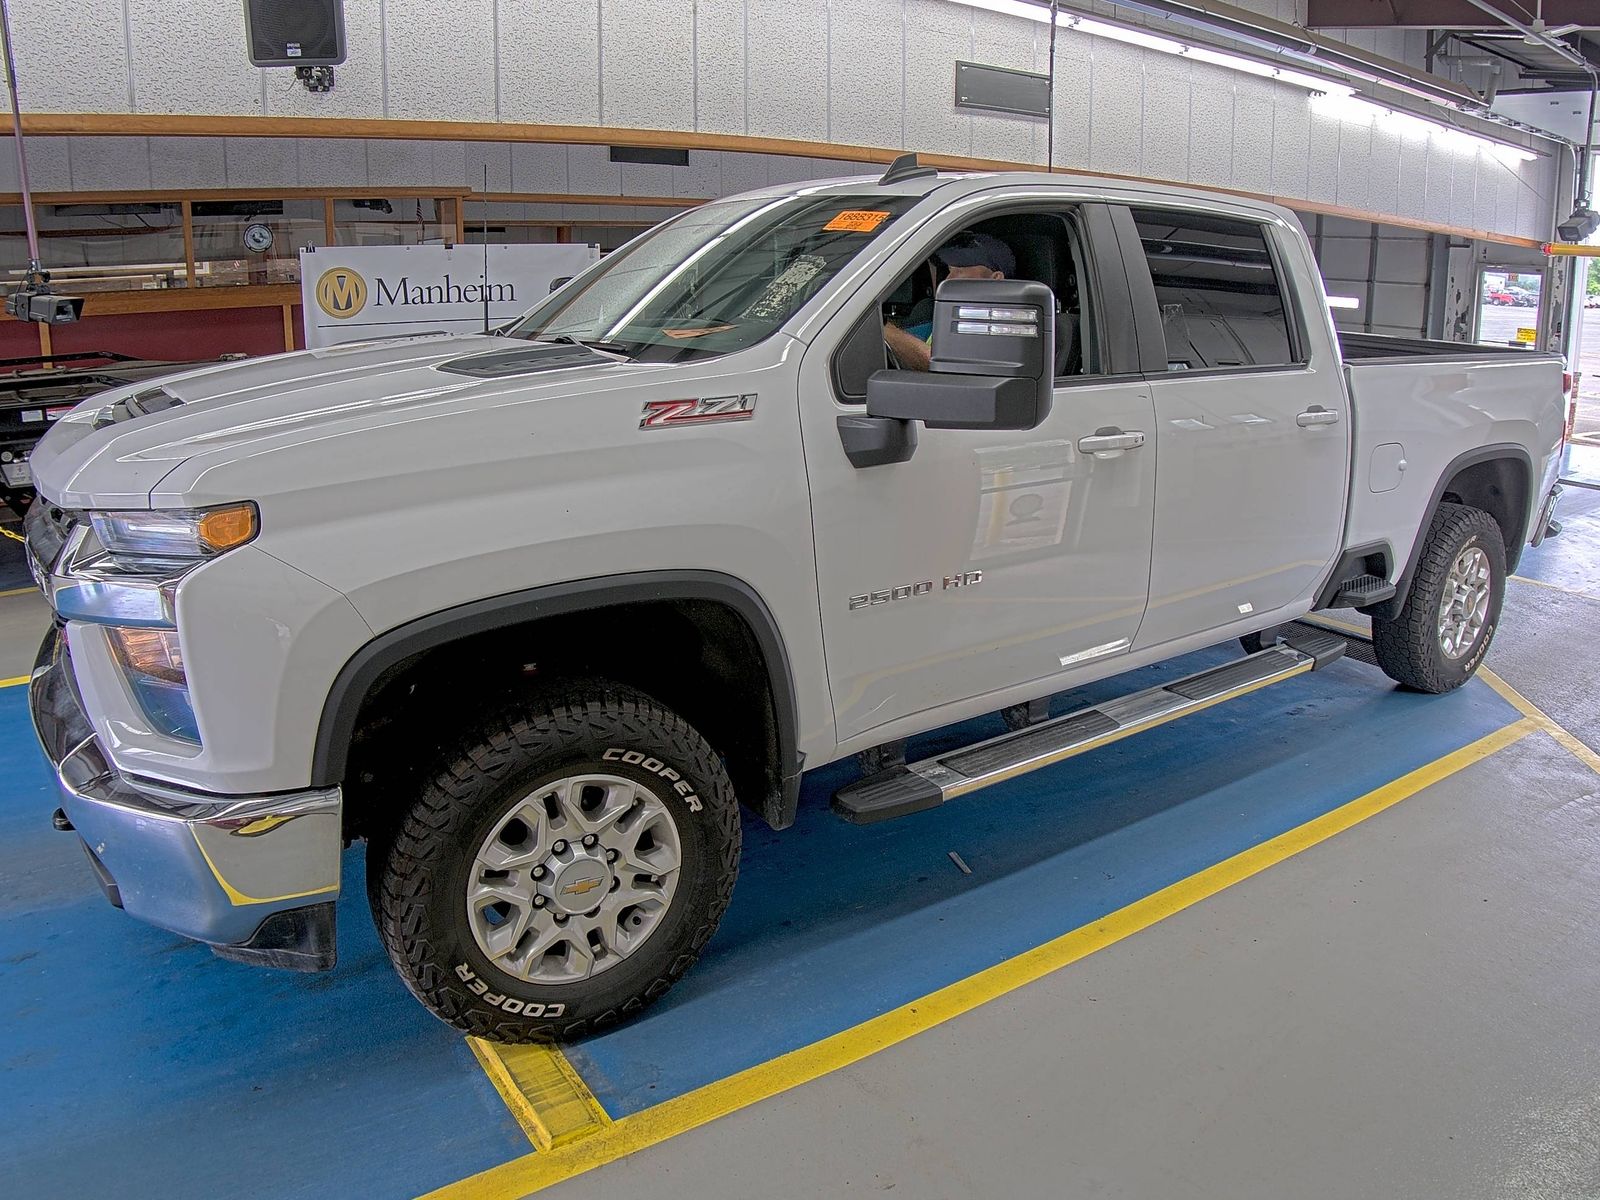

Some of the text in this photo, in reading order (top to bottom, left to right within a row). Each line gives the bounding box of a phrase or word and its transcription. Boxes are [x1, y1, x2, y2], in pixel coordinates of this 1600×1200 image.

[373, 274, 517, 306] Manheim
[639, 393, 758, 430] Z71
[849, 570, 982, 610] 2500 HD
[1464, 624, 1494, 672] COOPER
[602, 748, 703, 813] COOPER
[455, 962, 566, 1018] COOPER
